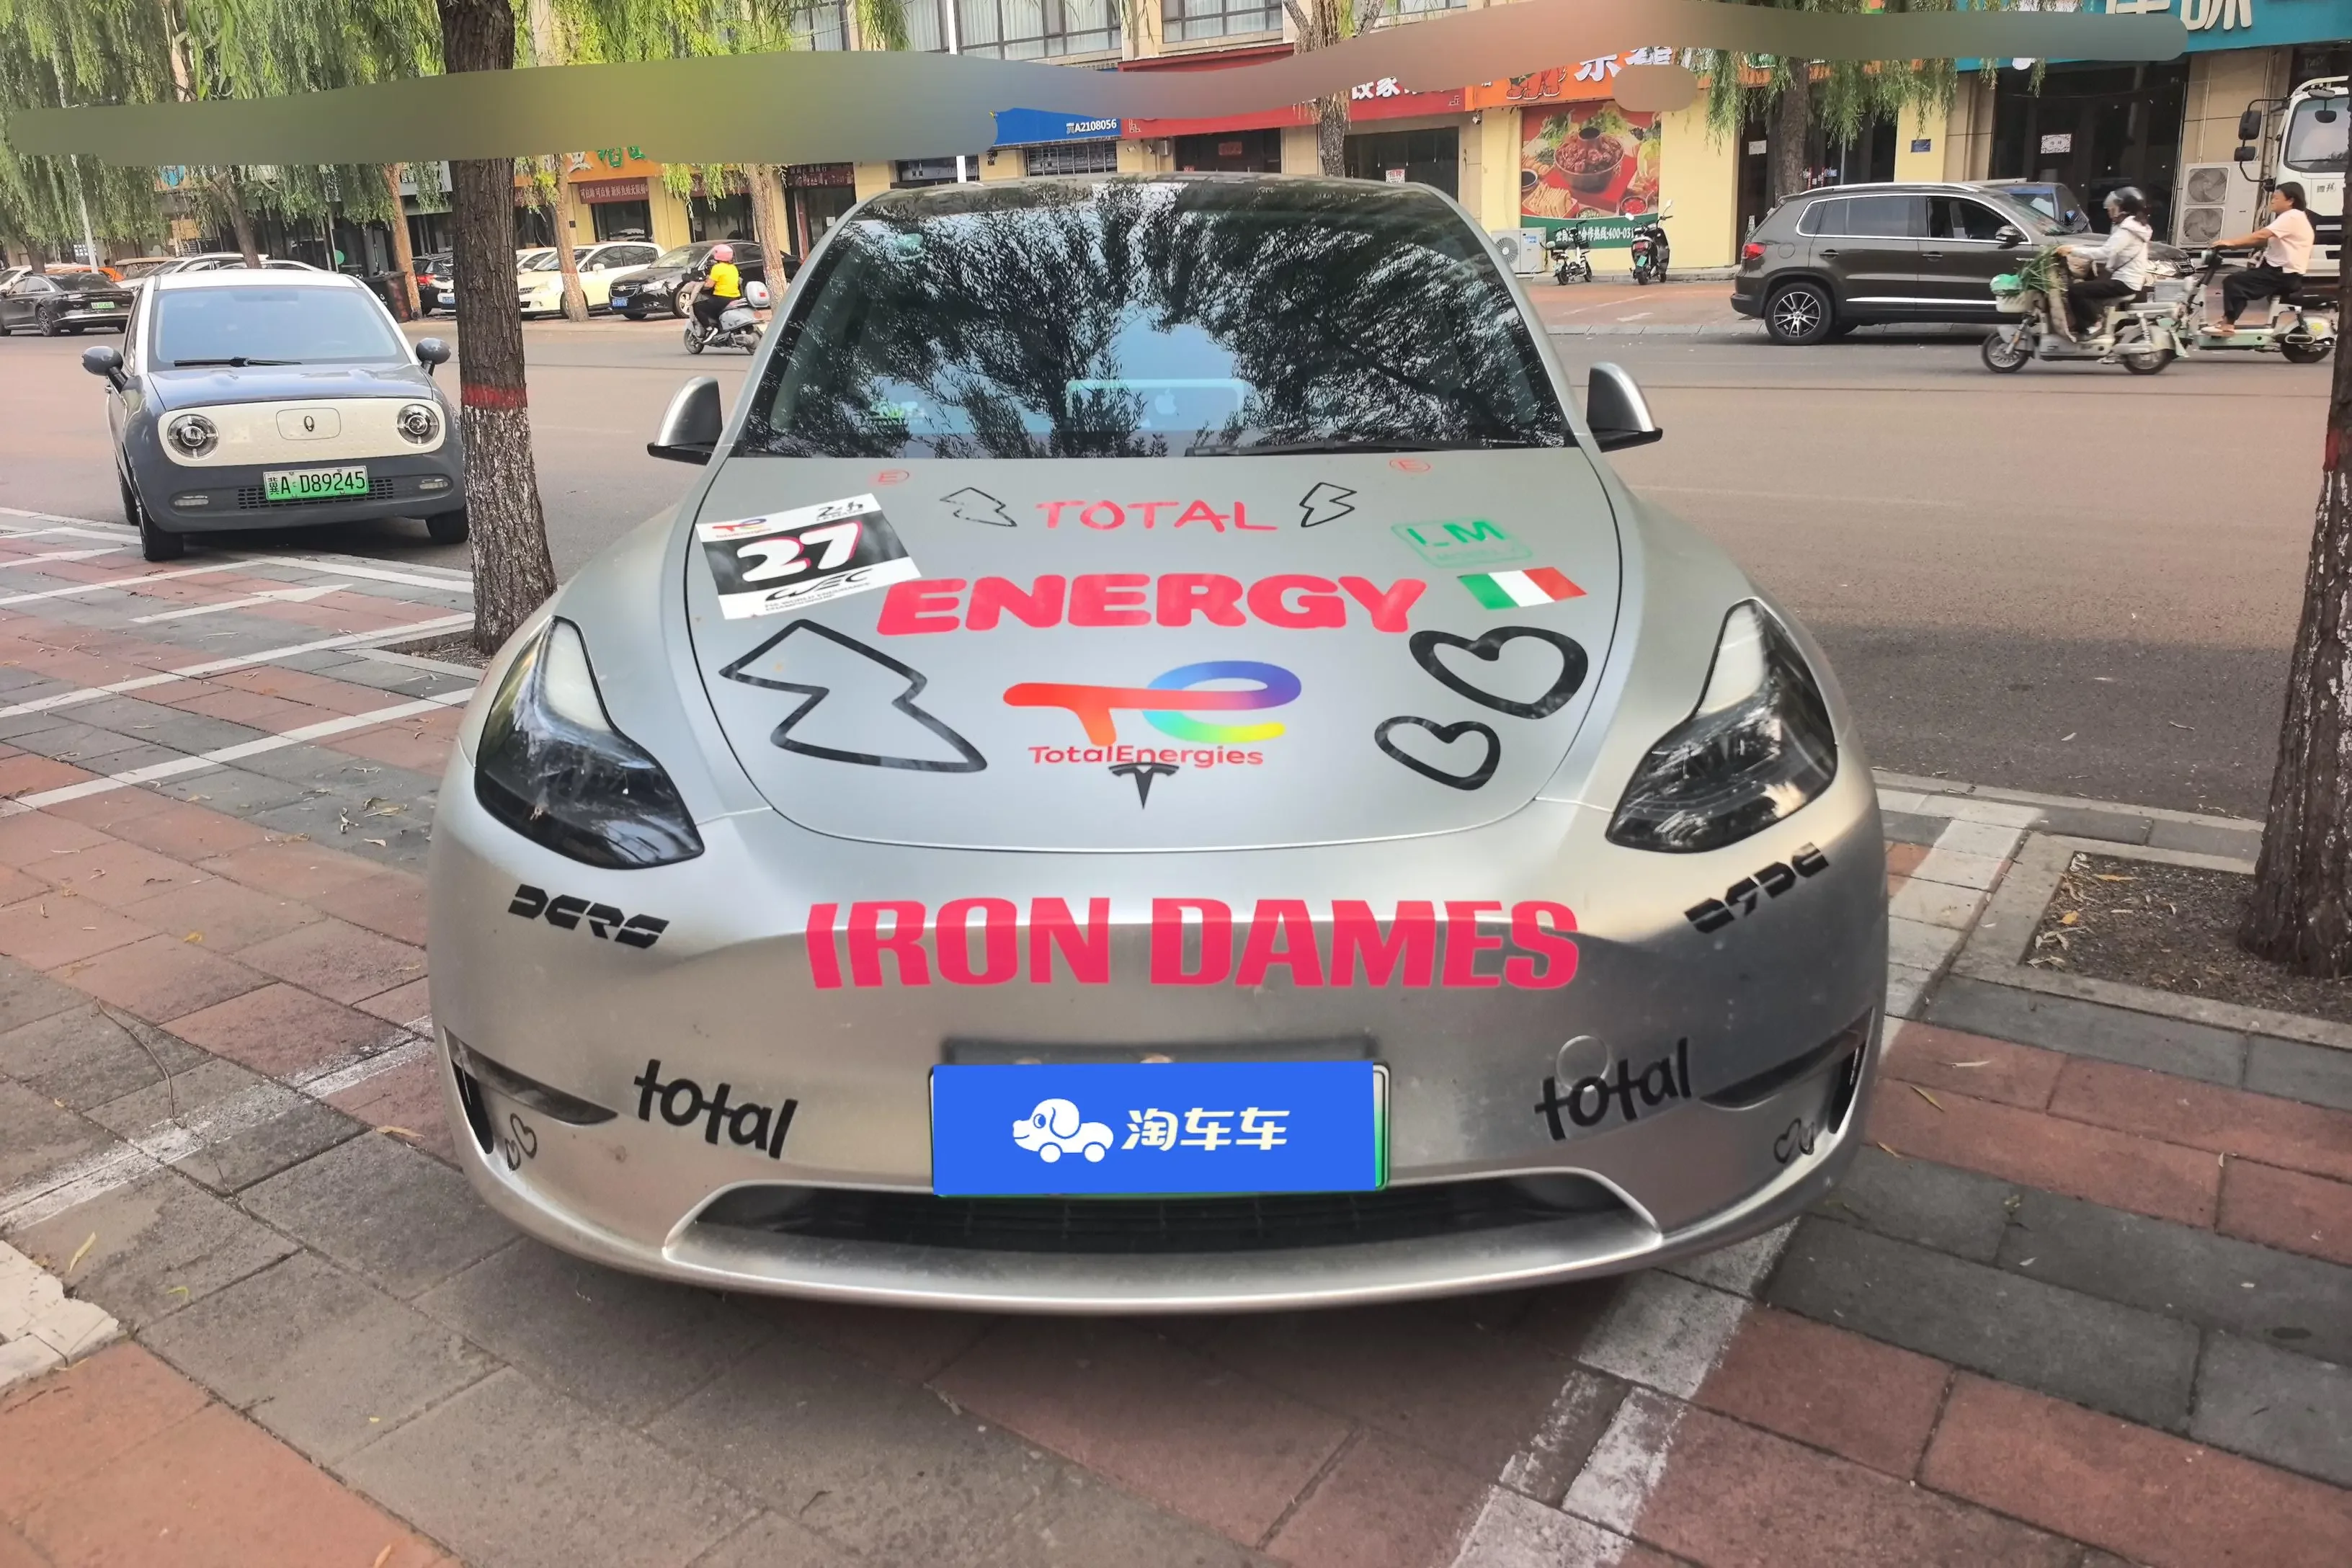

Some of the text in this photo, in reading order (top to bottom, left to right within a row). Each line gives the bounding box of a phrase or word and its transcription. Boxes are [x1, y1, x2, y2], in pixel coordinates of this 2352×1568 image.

[1038, 501, 1276, 533] TOTAL
[736, 521, 863, 582] 27
[877, 574, 1427, 636] ENERGY
[1028, 742, 1263, 768] TotalEnergies
[806, 897, 1580, 990] IRON DAMES
[633, 1059, 798, 1159] total
[1533, 1036, 1692, 1141] total
